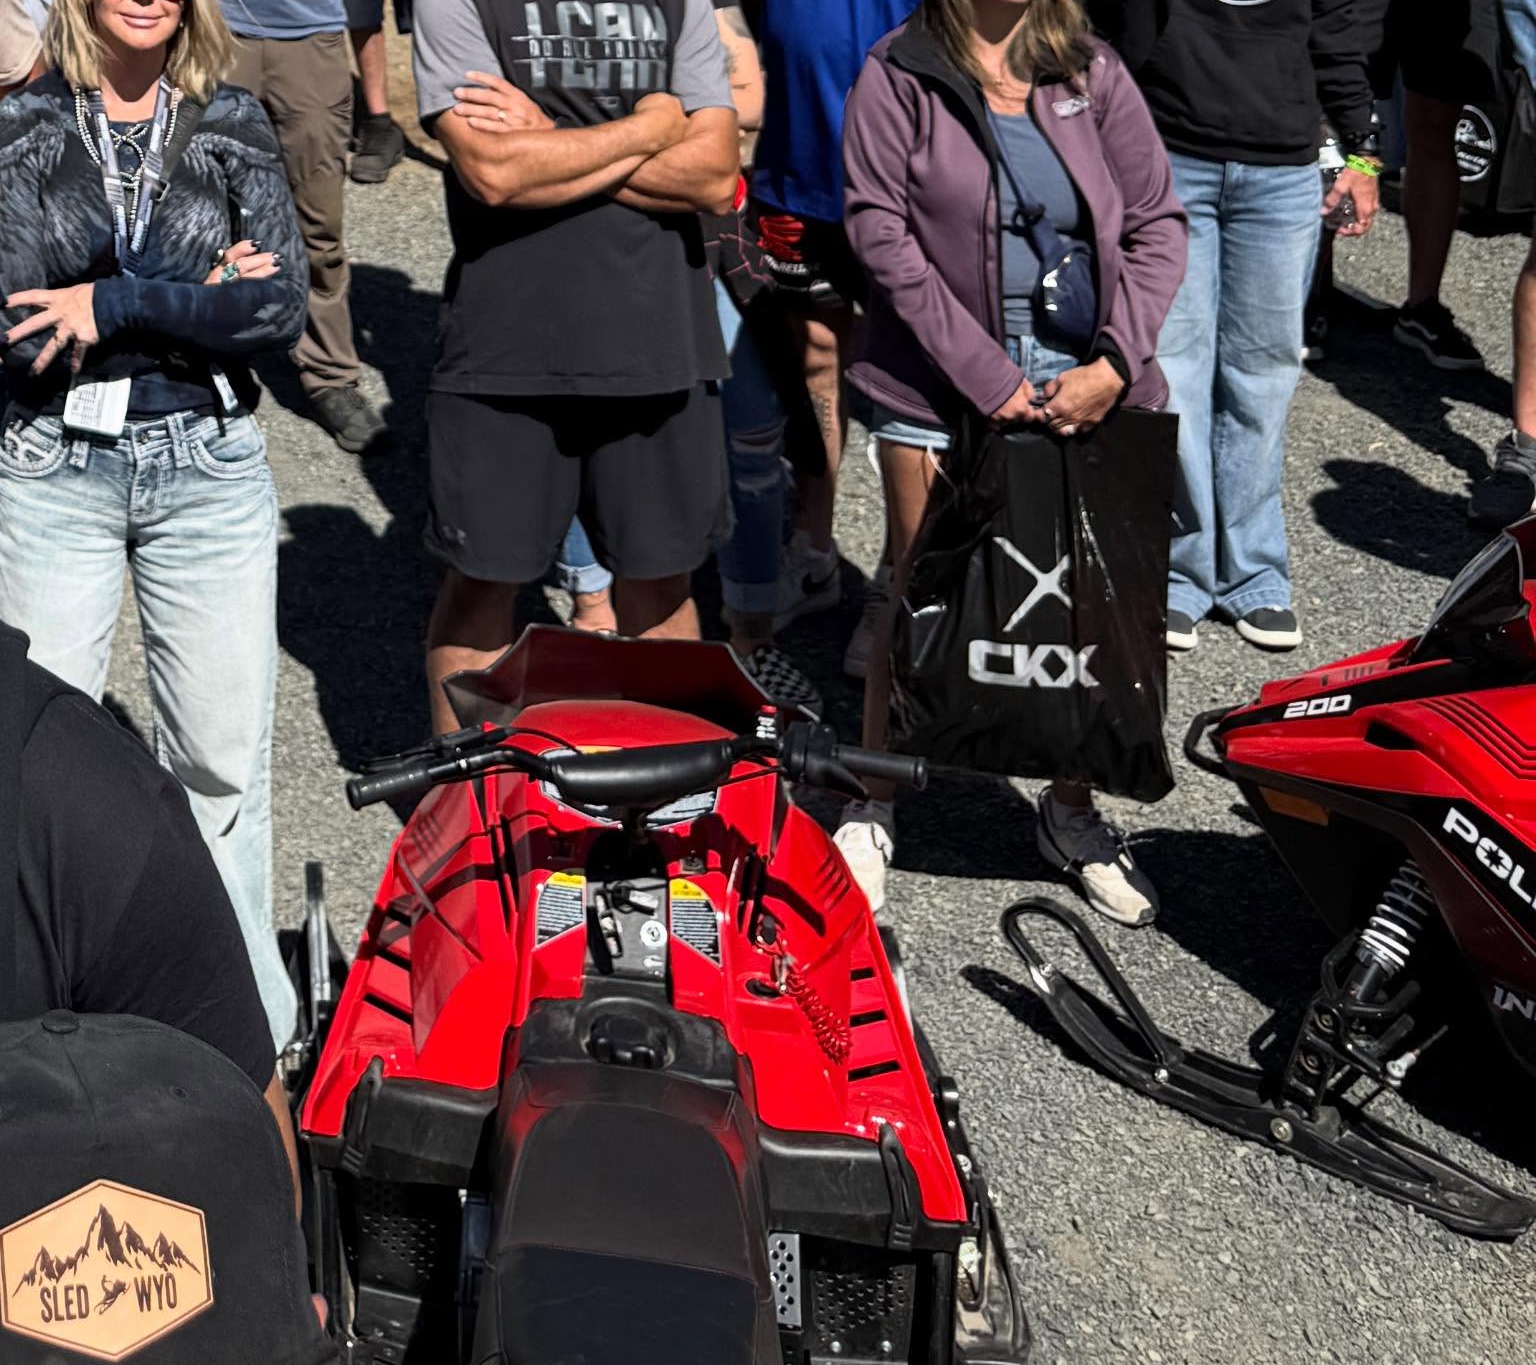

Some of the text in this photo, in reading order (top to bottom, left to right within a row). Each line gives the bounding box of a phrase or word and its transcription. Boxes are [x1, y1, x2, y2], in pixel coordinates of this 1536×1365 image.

[968, 639, 1100, 689] CKX
[1283, 693, 1353, 718] 200
[1442, 807, 1536, 910] POL
[1493, 985, 1536, 1020] IN
[40, 1272, 178, 1324] SLED WYO
